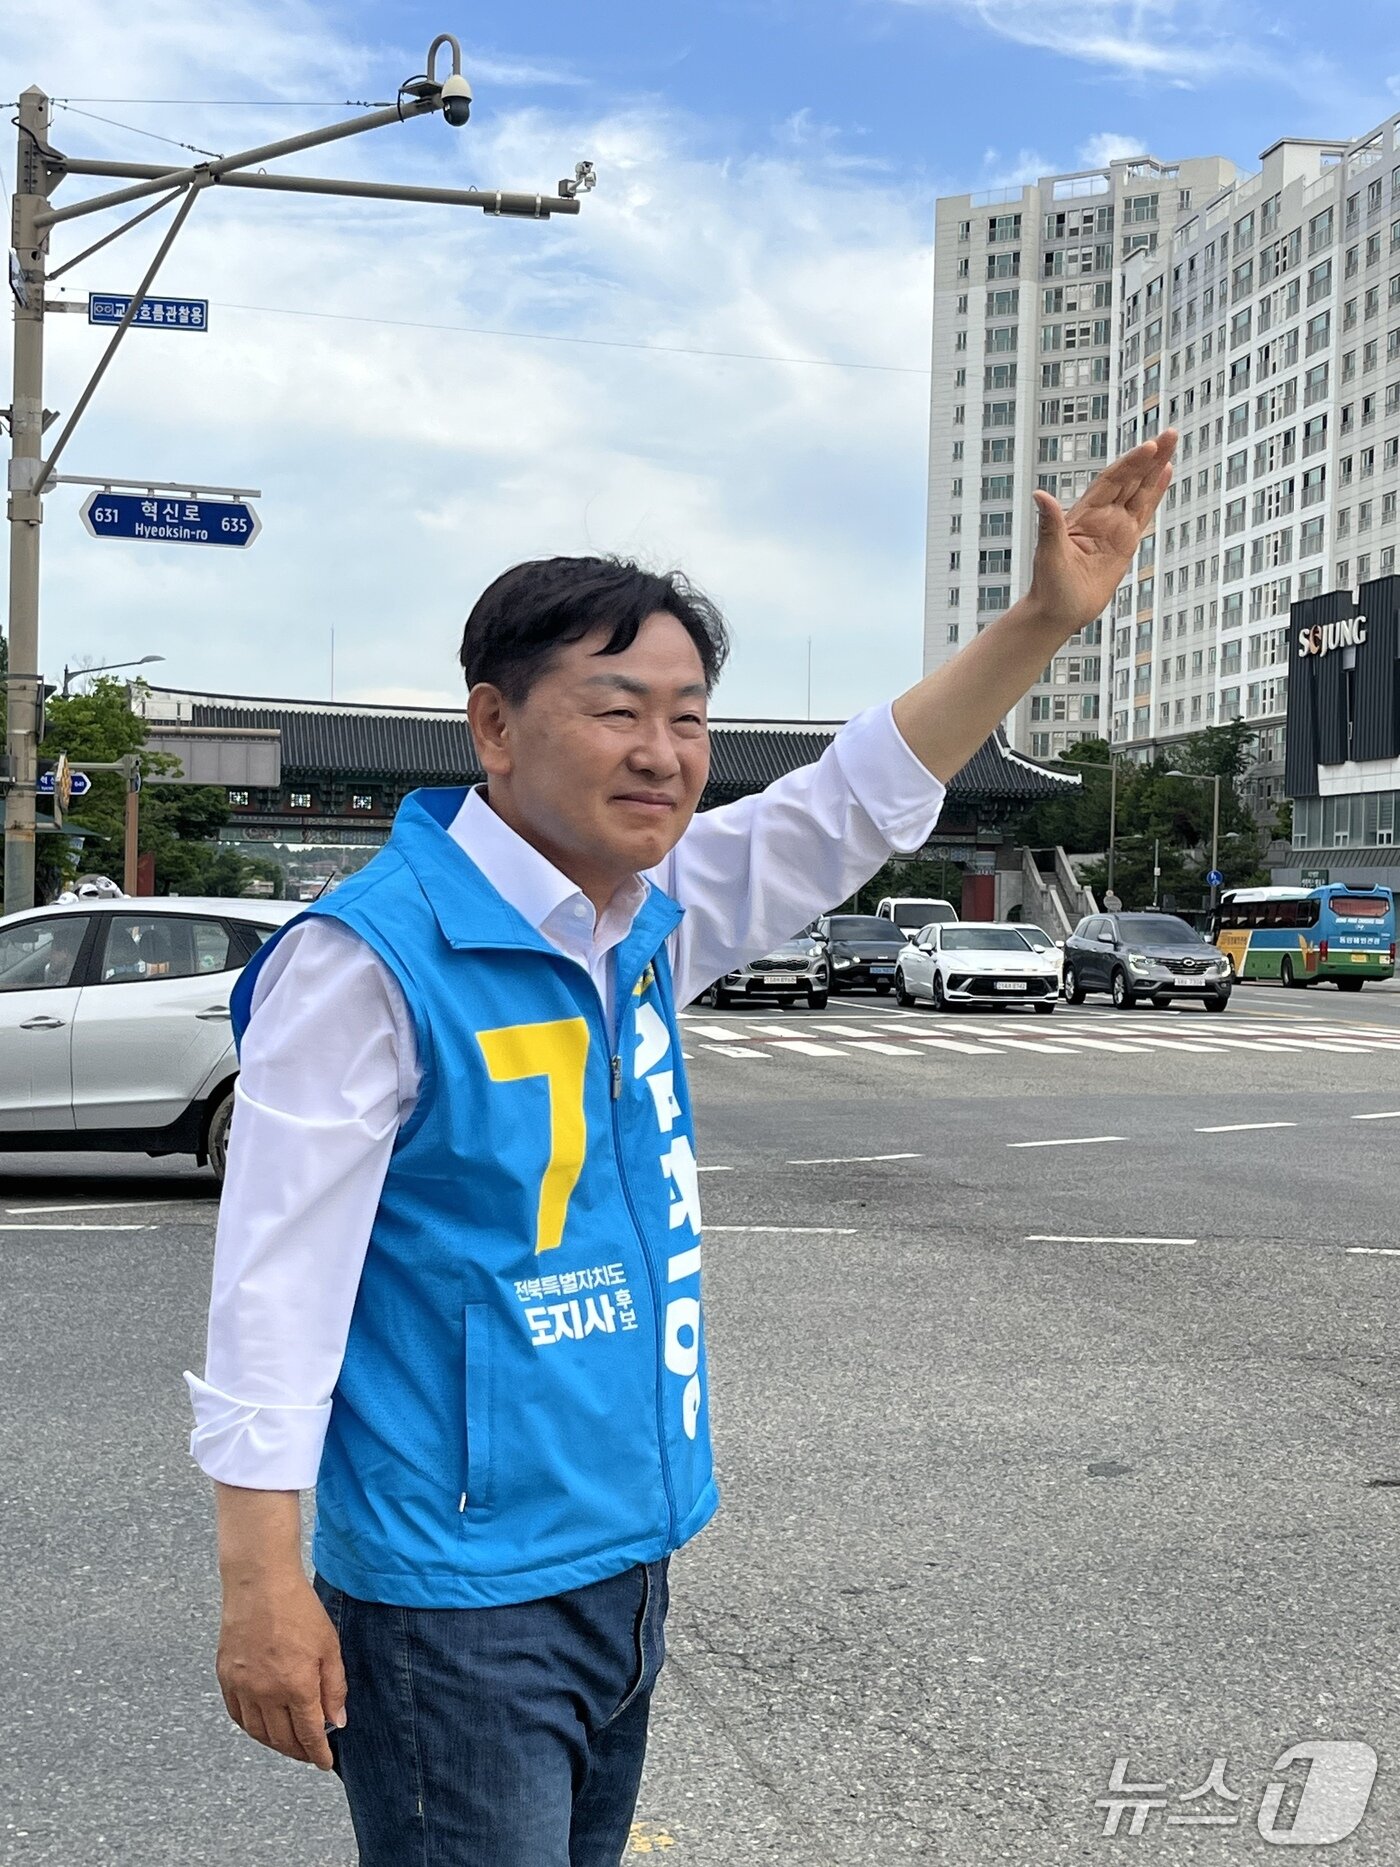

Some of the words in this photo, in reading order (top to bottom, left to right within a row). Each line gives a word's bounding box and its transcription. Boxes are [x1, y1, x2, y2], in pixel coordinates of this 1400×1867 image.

[114, 303, 202, 324] 교흐름관찰용
[95, 508, 119, 523] 631
[141, 501, 201, 522] 혁신로
[221, 517, 248, 533] 635
[135, 522, 208, 540] Hyeoksin-ro
[476, 1018, 590, 1255] 7
[513, 1262, 627, 1302] 전북특별자치도
[524, 1293, 617, 1346] 도지사
[614, 1288, 639, 1331] 후보
